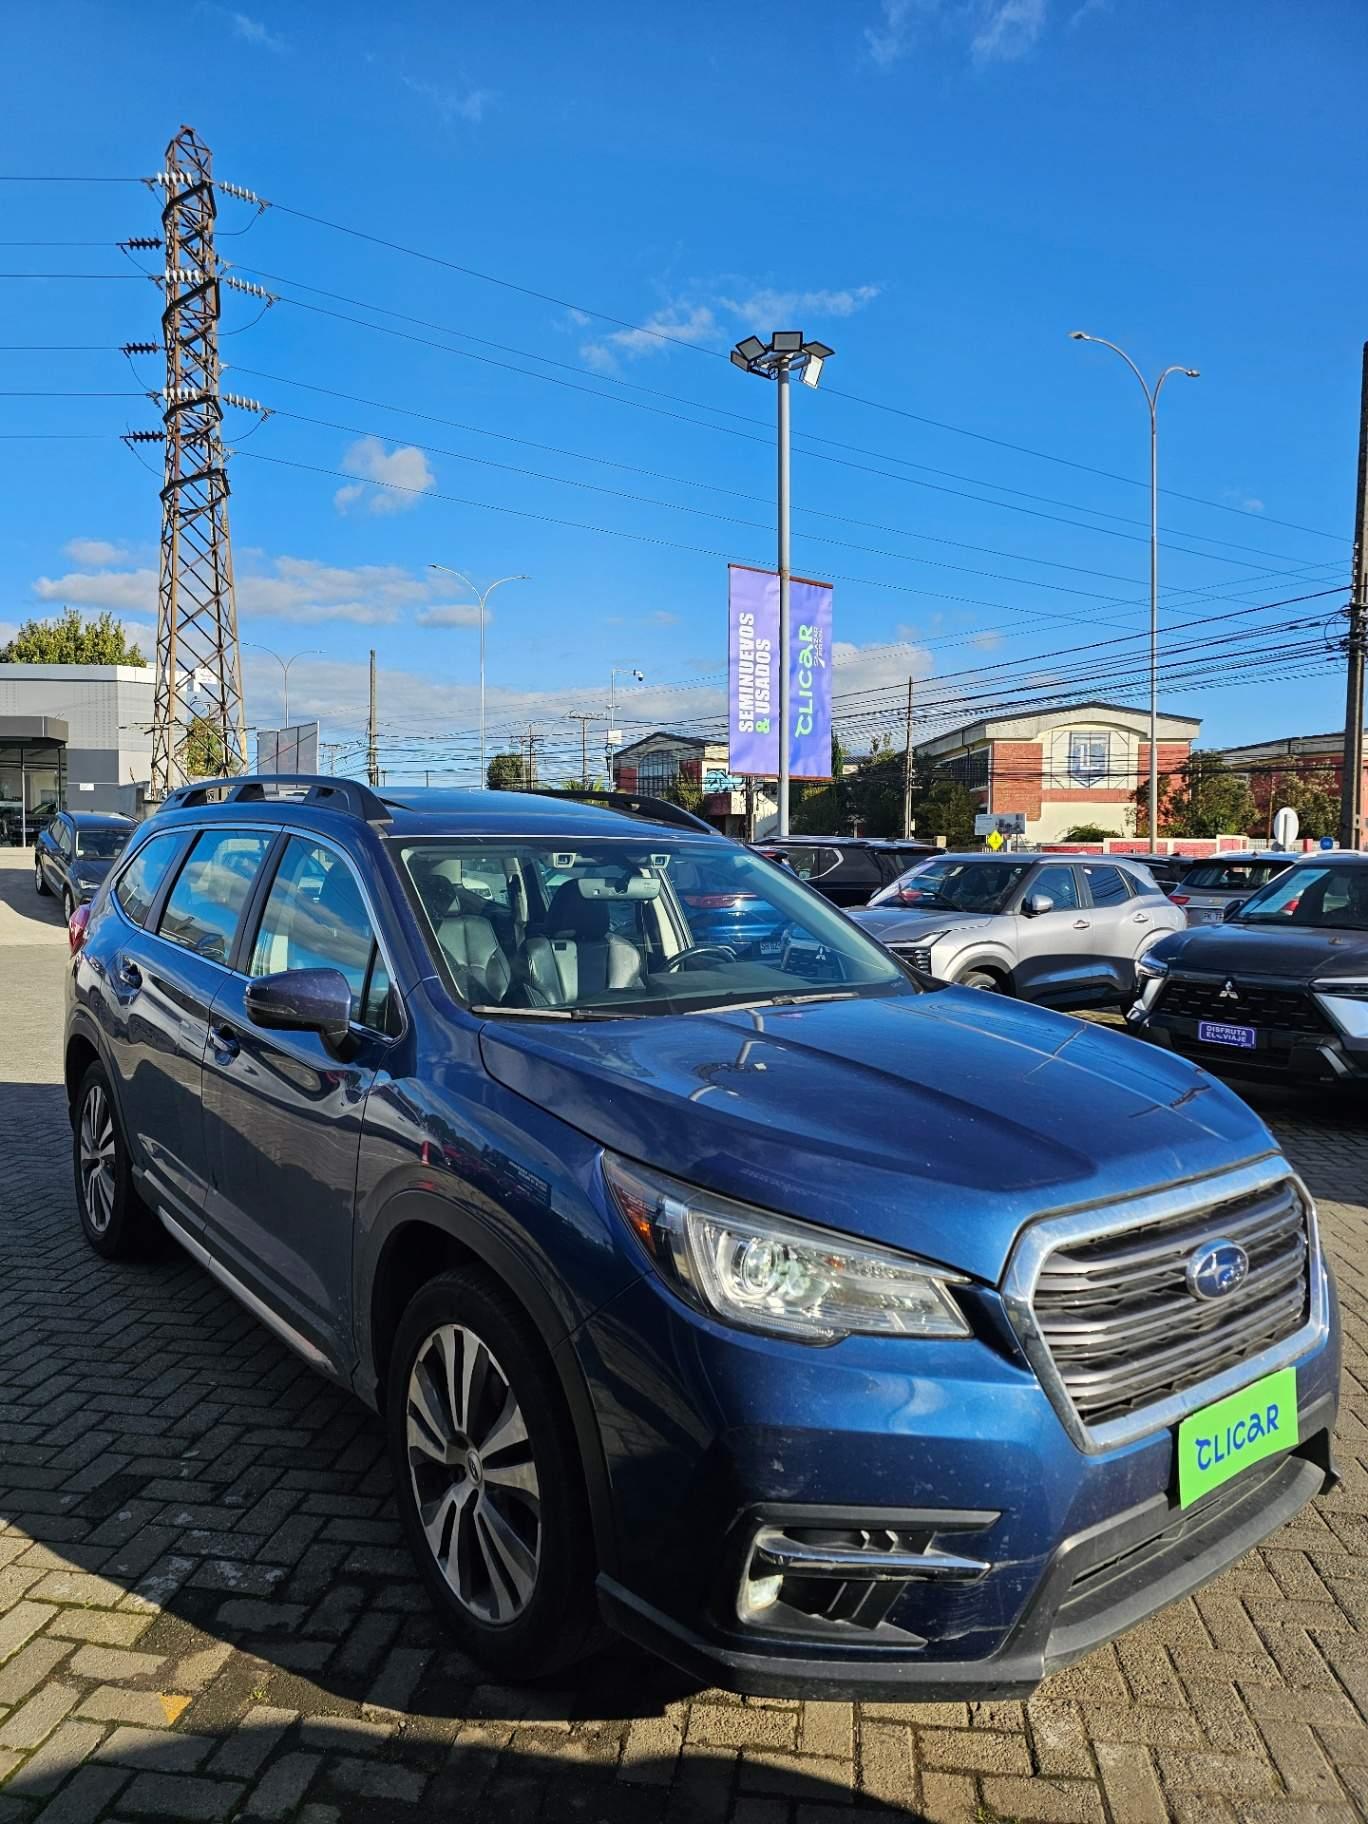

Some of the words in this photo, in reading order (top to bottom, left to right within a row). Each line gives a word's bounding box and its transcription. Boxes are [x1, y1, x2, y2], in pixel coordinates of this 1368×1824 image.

[739, 613, 754, 732] SEMINUEVOS
[755, 639, 771, 714] USADOS
[755, 718, 771, 734] &
[1206, 1025, 1247, 1036] DISFRUTA
[1206, 1031, 1216, 1039] EL
[1223, 1033, 1247, 1042] VIAJE
